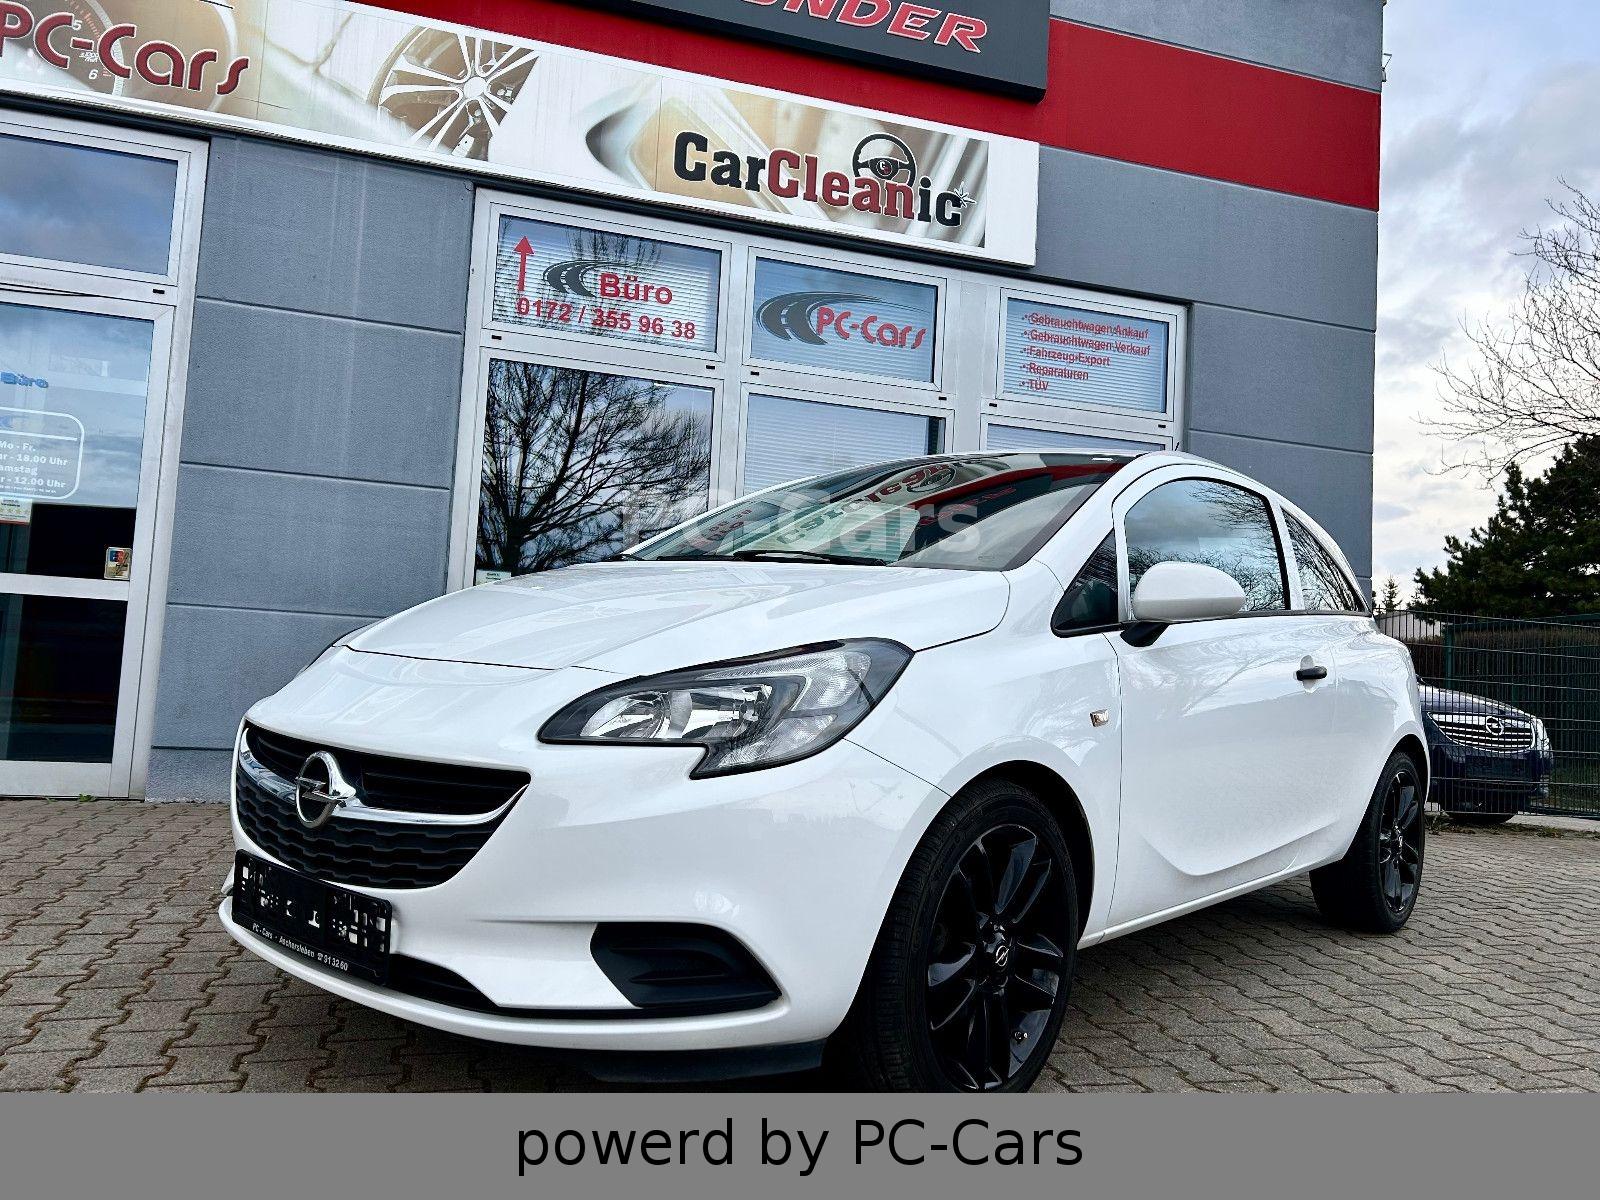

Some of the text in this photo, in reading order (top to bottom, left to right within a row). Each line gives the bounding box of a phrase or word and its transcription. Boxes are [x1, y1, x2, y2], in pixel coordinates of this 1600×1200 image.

[0, 2, 250, 95] PC-Cars
[672, 130, 963, 227] CarCleanic
[600, 272, 673, 304] Büro
[516, 297, 573, 324] 0172
[638, 315, 665, 335] 96
[671, 320, 696, 340] 38
[816, 306, 928, 350] PC-Cars
[1027, 362, 1089, 381] Reparaturen
[1028, 376, 1049, 391] TÜV
[49, 456, 68, 465] Uhr
